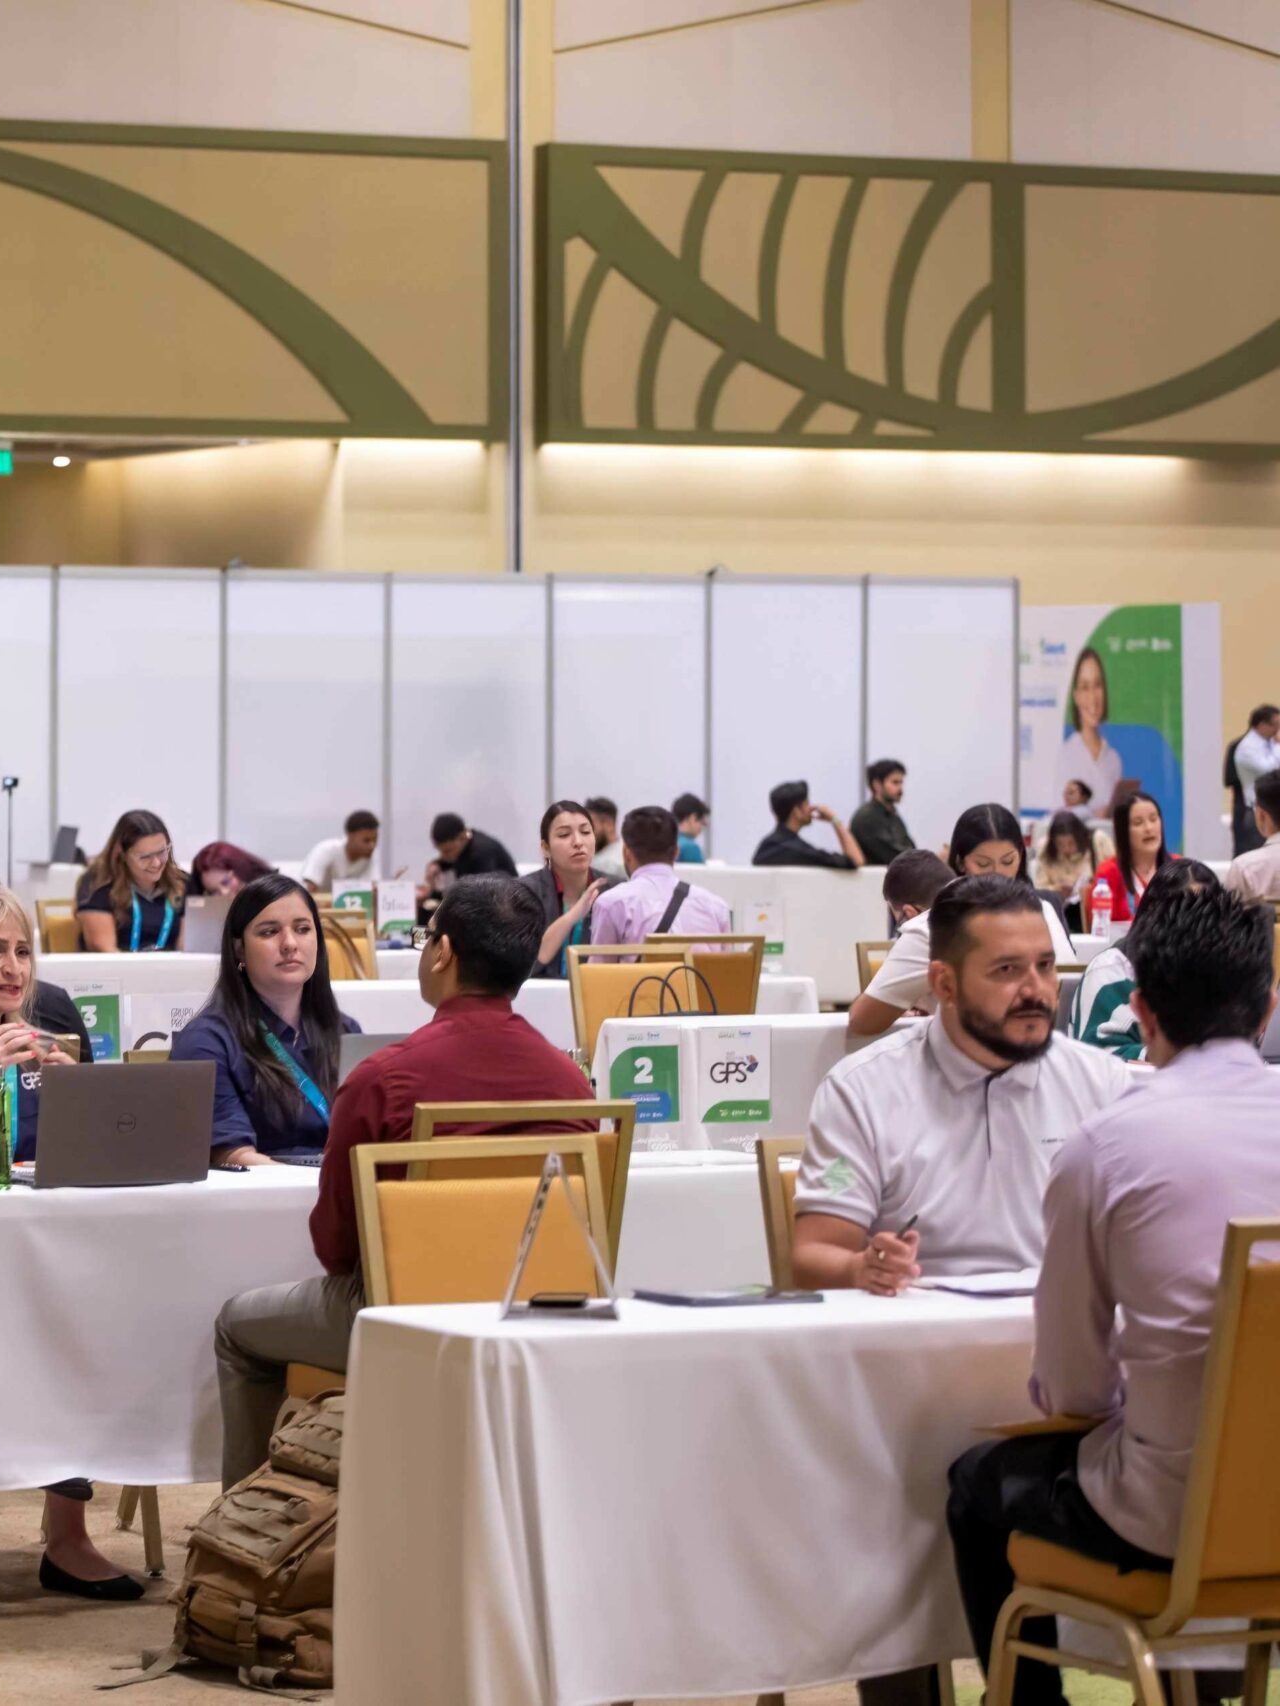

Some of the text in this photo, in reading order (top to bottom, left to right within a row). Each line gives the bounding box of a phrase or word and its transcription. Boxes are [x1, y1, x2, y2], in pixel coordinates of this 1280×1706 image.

[80, 1005, 97, 1028] 3
[634, 1057, 653, 1084] 2
[710, 1061, 747, 1083] GPS
